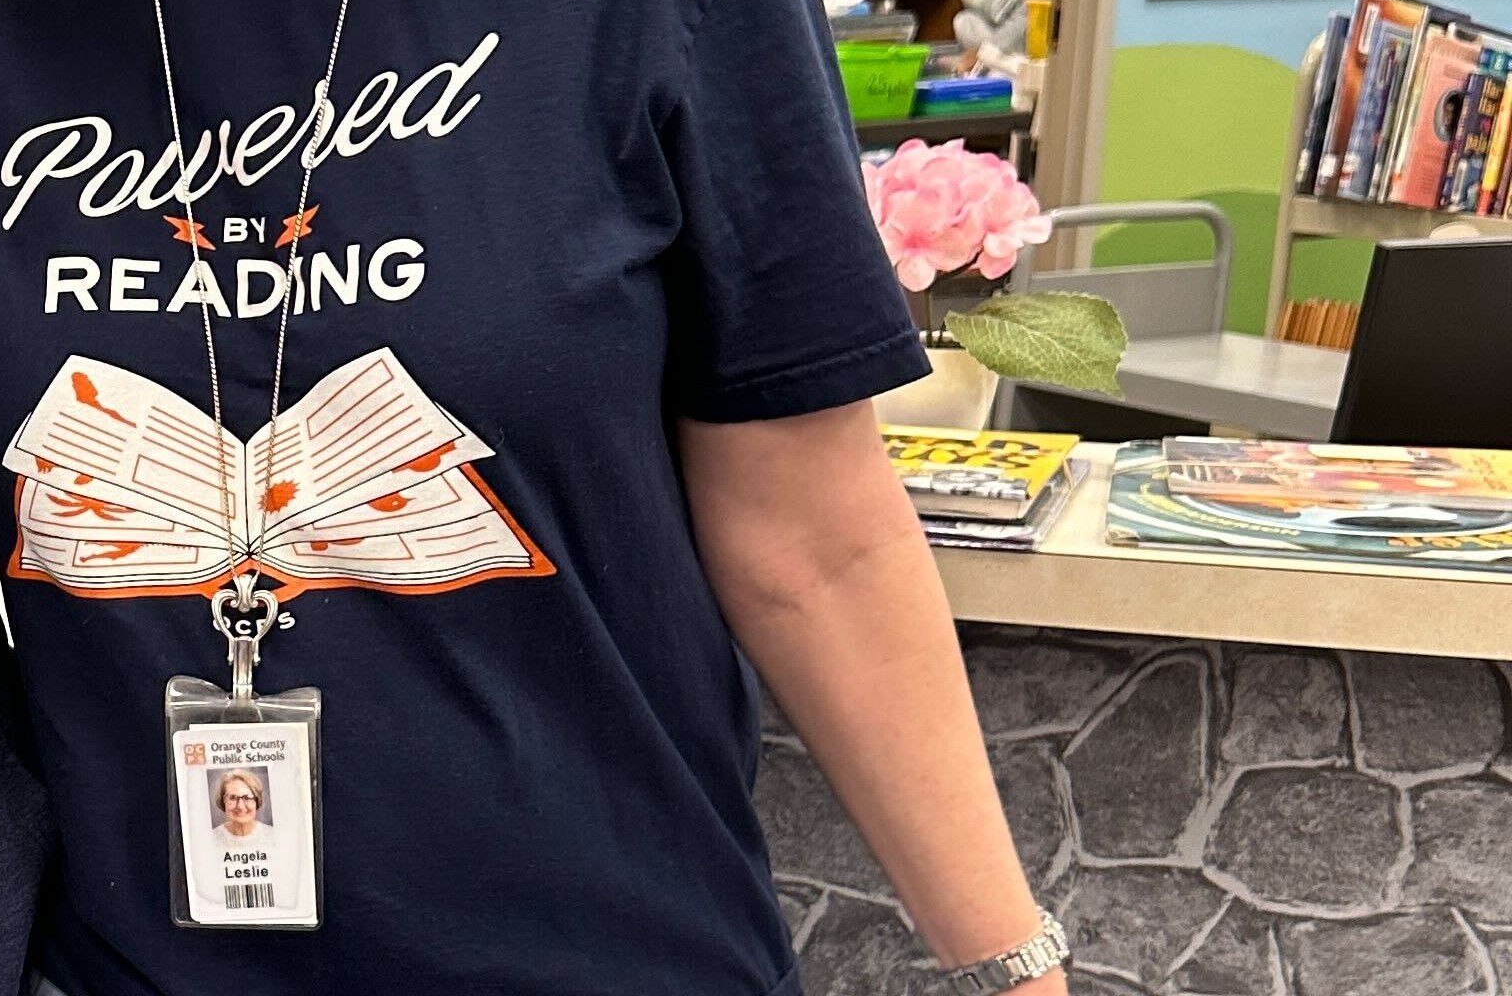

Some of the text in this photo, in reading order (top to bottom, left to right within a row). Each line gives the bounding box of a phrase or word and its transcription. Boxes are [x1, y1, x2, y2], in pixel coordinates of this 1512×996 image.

[1, 32, 500, 231] Powered
[223, 216, 267, 244] BY
[44, 238, 426, 319] READING
[211, 739, 287, 754] Orange County
[212, 752, 285, 765] Public Schools
[224, 851, 268, 864] Angela
[225, 867, 269, 879] Leslie
